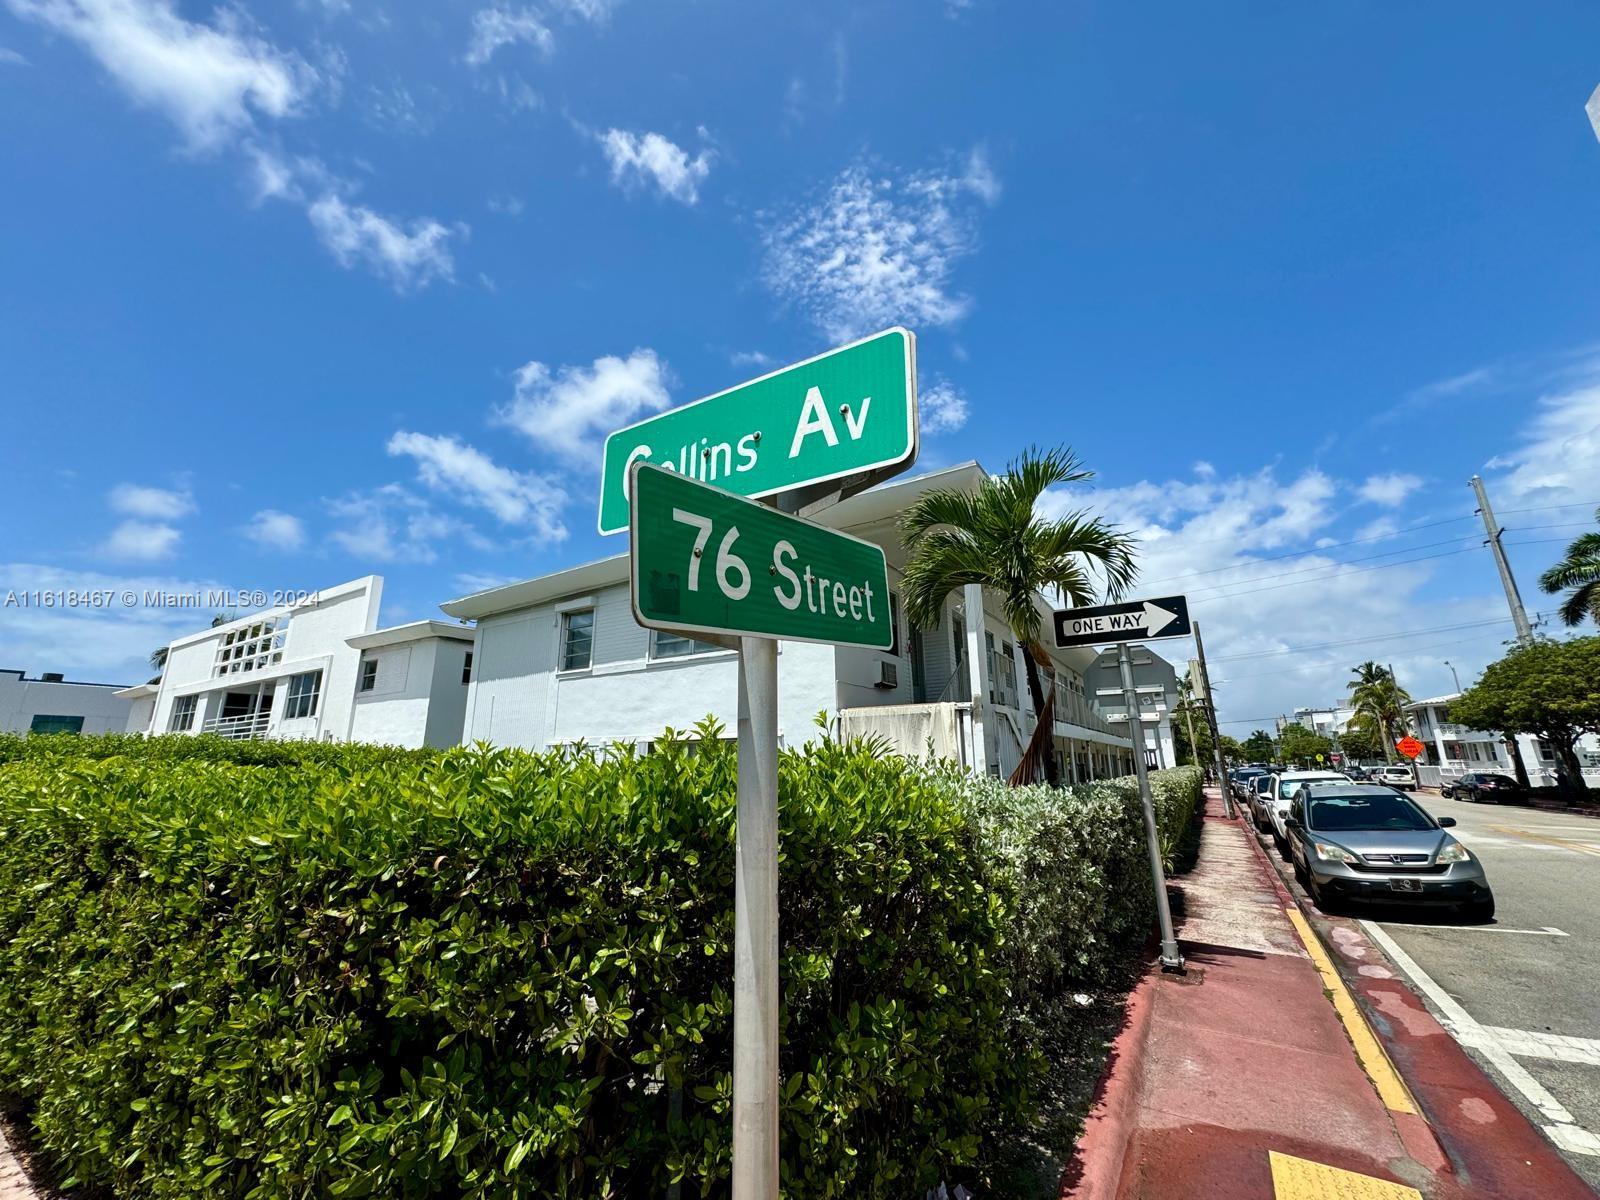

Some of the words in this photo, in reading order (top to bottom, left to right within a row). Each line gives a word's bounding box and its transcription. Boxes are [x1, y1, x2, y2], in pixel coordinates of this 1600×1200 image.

[788, 385, 871, 459] Av
[672, 507, 751, 601] 76
[773, 539, 875, 622] Street
[1072, 619, 1103, 633] ONE
[1109, 614, 1142, 630] WAY
